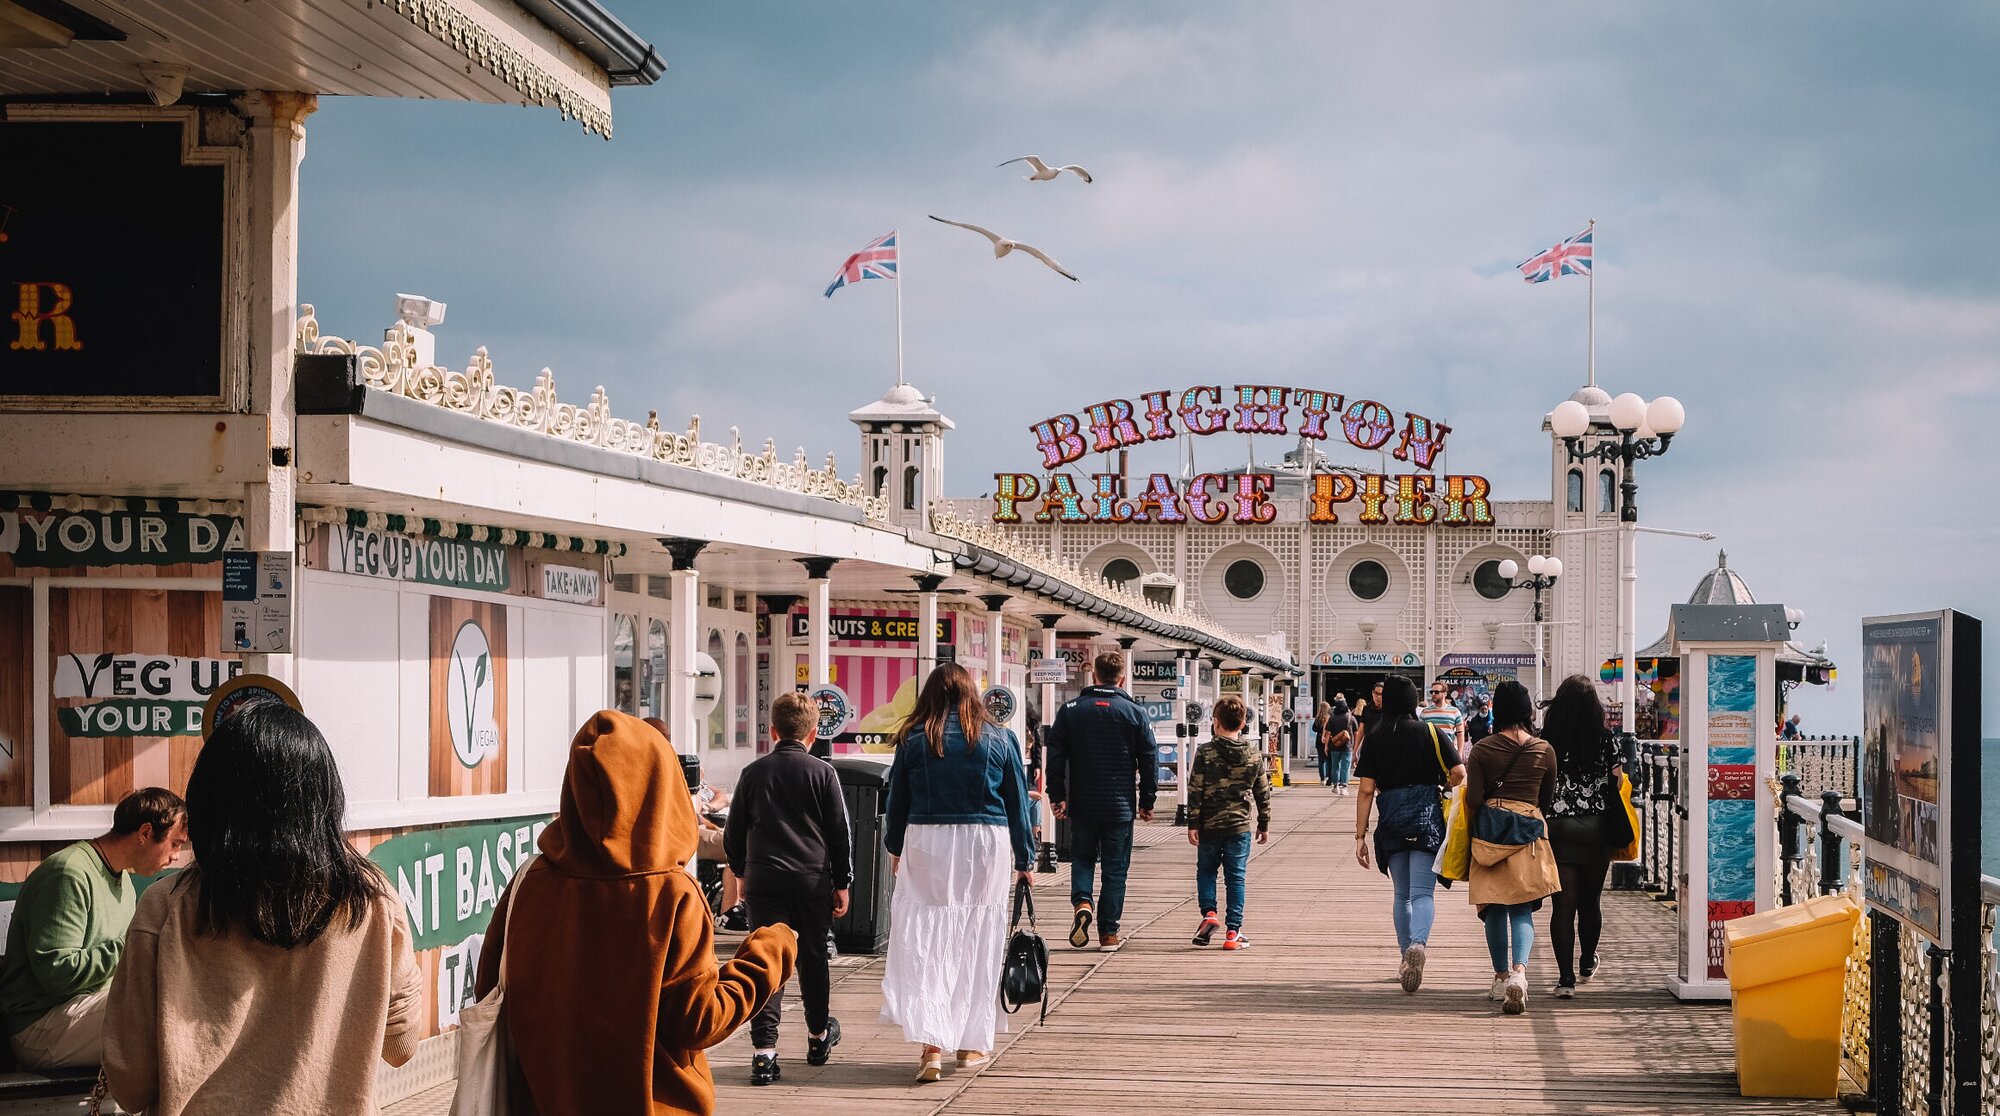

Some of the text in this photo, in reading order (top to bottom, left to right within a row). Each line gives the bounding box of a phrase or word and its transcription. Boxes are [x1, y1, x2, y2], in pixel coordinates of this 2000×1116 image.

[1029, 384, 1452, 470] BRIGHTON
[993, 472, 1496, 526] PALACE PIER
[25, 515, 244, 553] YOUR DA
[415, 539, 468, 582] YOUR
[473, 546, 504, 585] DAY
[798, 618, 944, 638] DNUTS & CRES
[1347, 653, 1387, 661] THIS WAY
[1449, 657, 1470, 665] WHERE
[1472, 657, 1495, 665] TICKETS
[1497, 657, 1514, 665] MAKE
[74, 706, 172, 732] YOUR
[474, 730, 499, 747] VEGAN
